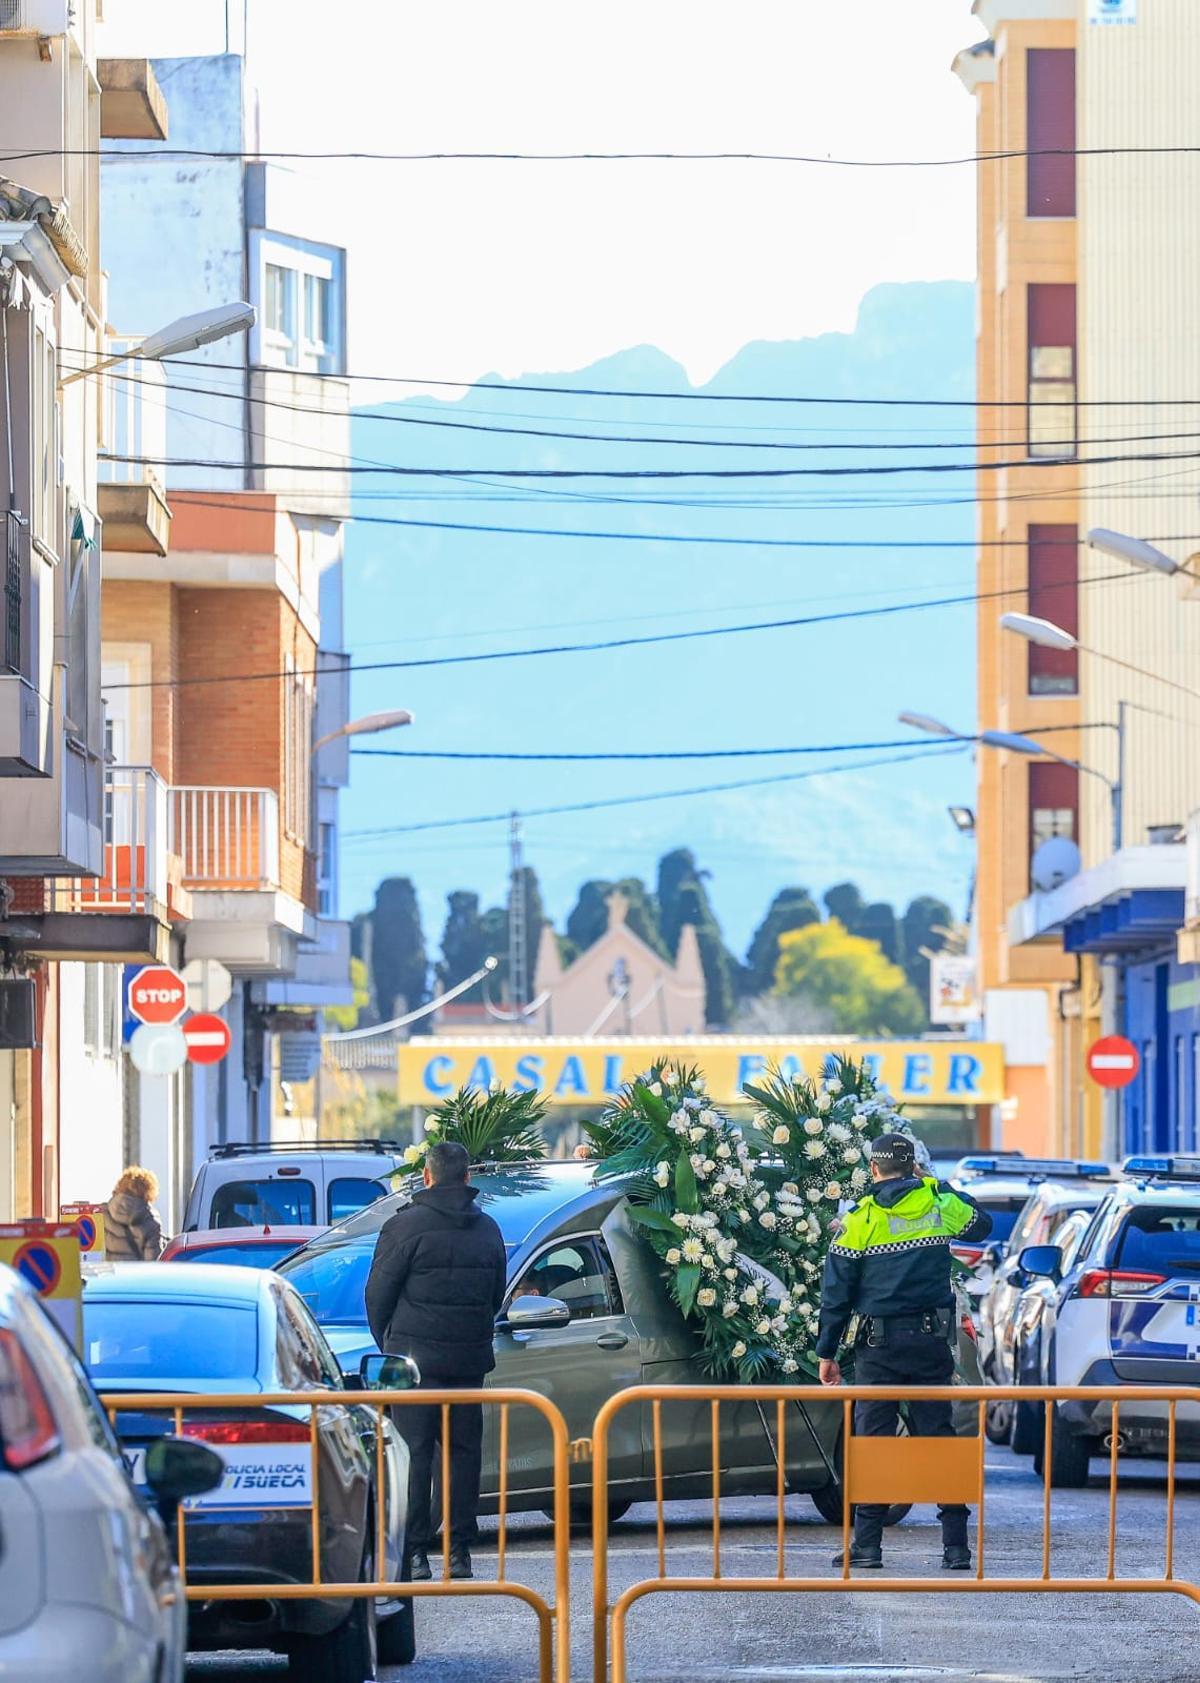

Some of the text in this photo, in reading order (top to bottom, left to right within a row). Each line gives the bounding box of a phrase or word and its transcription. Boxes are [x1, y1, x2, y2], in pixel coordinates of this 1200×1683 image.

[136, 988, 183, 1004] STOP
[422, 1054, 627, 1097] CASAL
[225, 1464, 305, 1474] OLICIA LOCAL
[242, 1475, 305, 1488] SUECA
